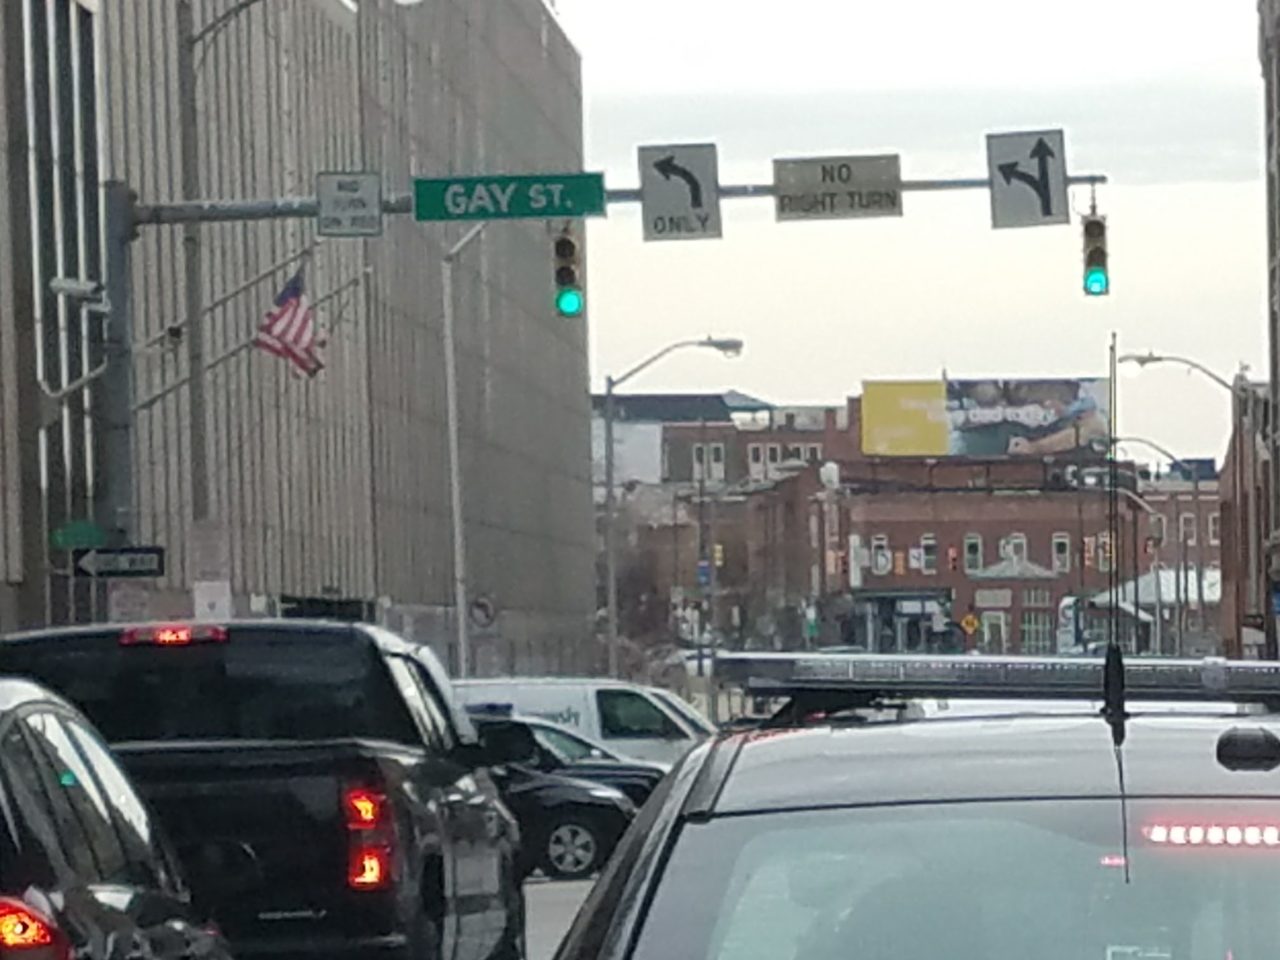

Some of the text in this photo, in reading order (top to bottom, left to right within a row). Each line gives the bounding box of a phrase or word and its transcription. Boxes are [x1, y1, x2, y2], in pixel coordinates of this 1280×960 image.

[821, 163, 852, 183] NO
[444, 182, 573, 215] GAY ST.
[779, 190, 898, 214] RIGHT TURN
[653, 213, 711, 235] ONLY
